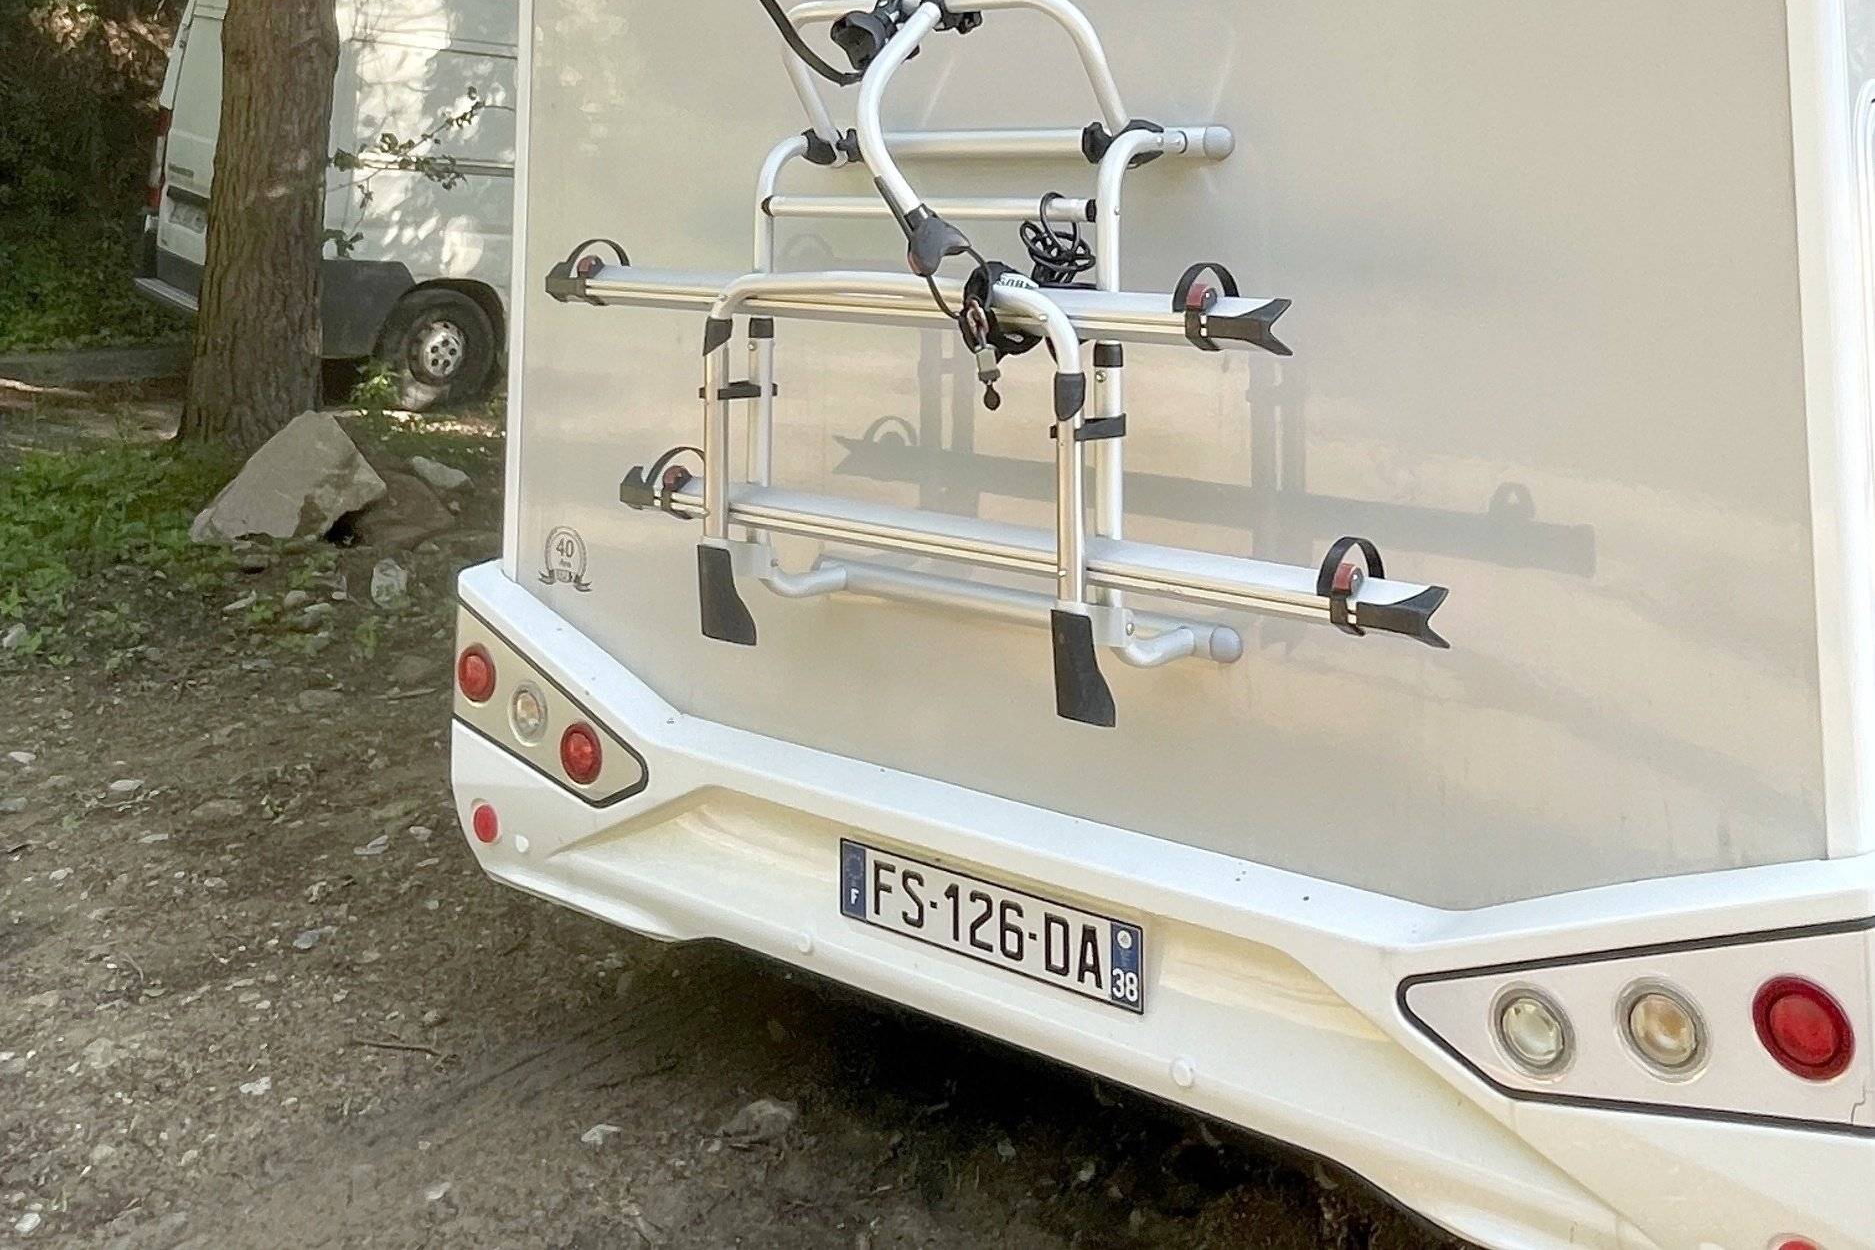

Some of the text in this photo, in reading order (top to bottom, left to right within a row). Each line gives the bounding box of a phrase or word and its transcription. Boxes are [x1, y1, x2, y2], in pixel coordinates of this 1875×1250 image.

[556, 538, 574, 558] 40
[850, 888, 860, 905] F
[873, 859, 1103, 989] FS-126-DA
[1111, 968, 1139, 1002] 38
